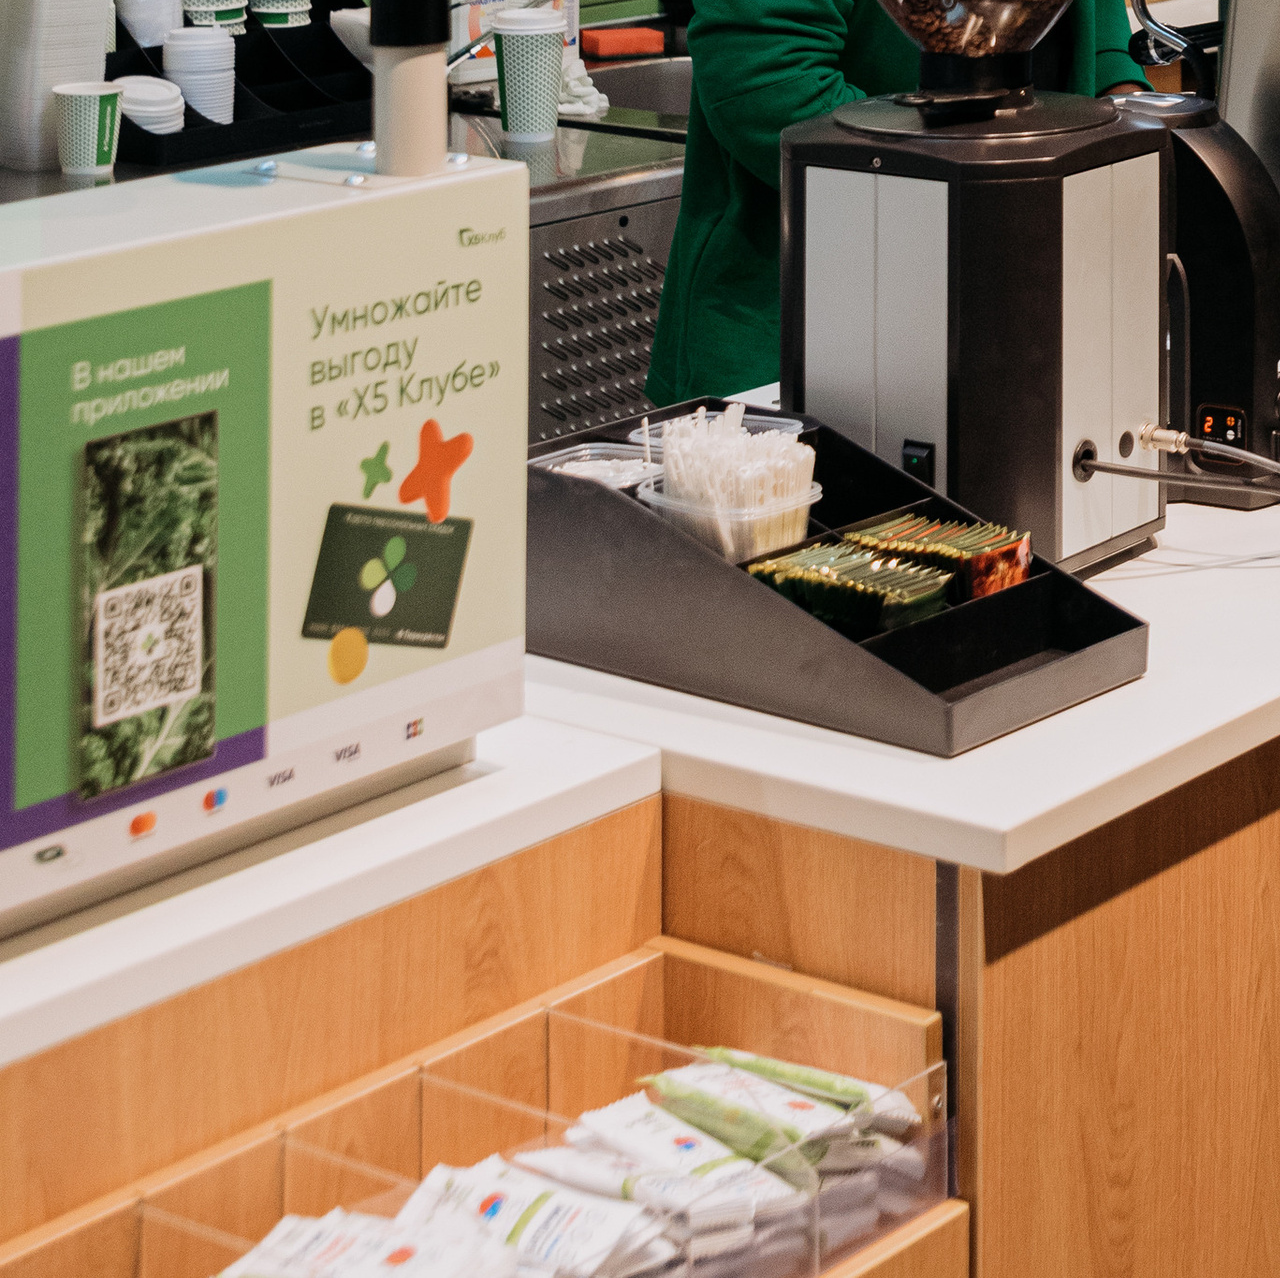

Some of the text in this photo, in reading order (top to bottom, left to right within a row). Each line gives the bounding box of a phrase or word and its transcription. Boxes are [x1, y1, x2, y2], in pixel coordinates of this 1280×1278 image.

[310, 279, 484, 340] Умножайте
[70, 345, 186, 392] В нашем
[309, 336, 419, 386] выгоду
[70, 368, 229, 427] приложении
[309, 405, 326, 432] в
[398, 359, 501, 407] Клубе»
[1203, 416, 1214, 433] 2
